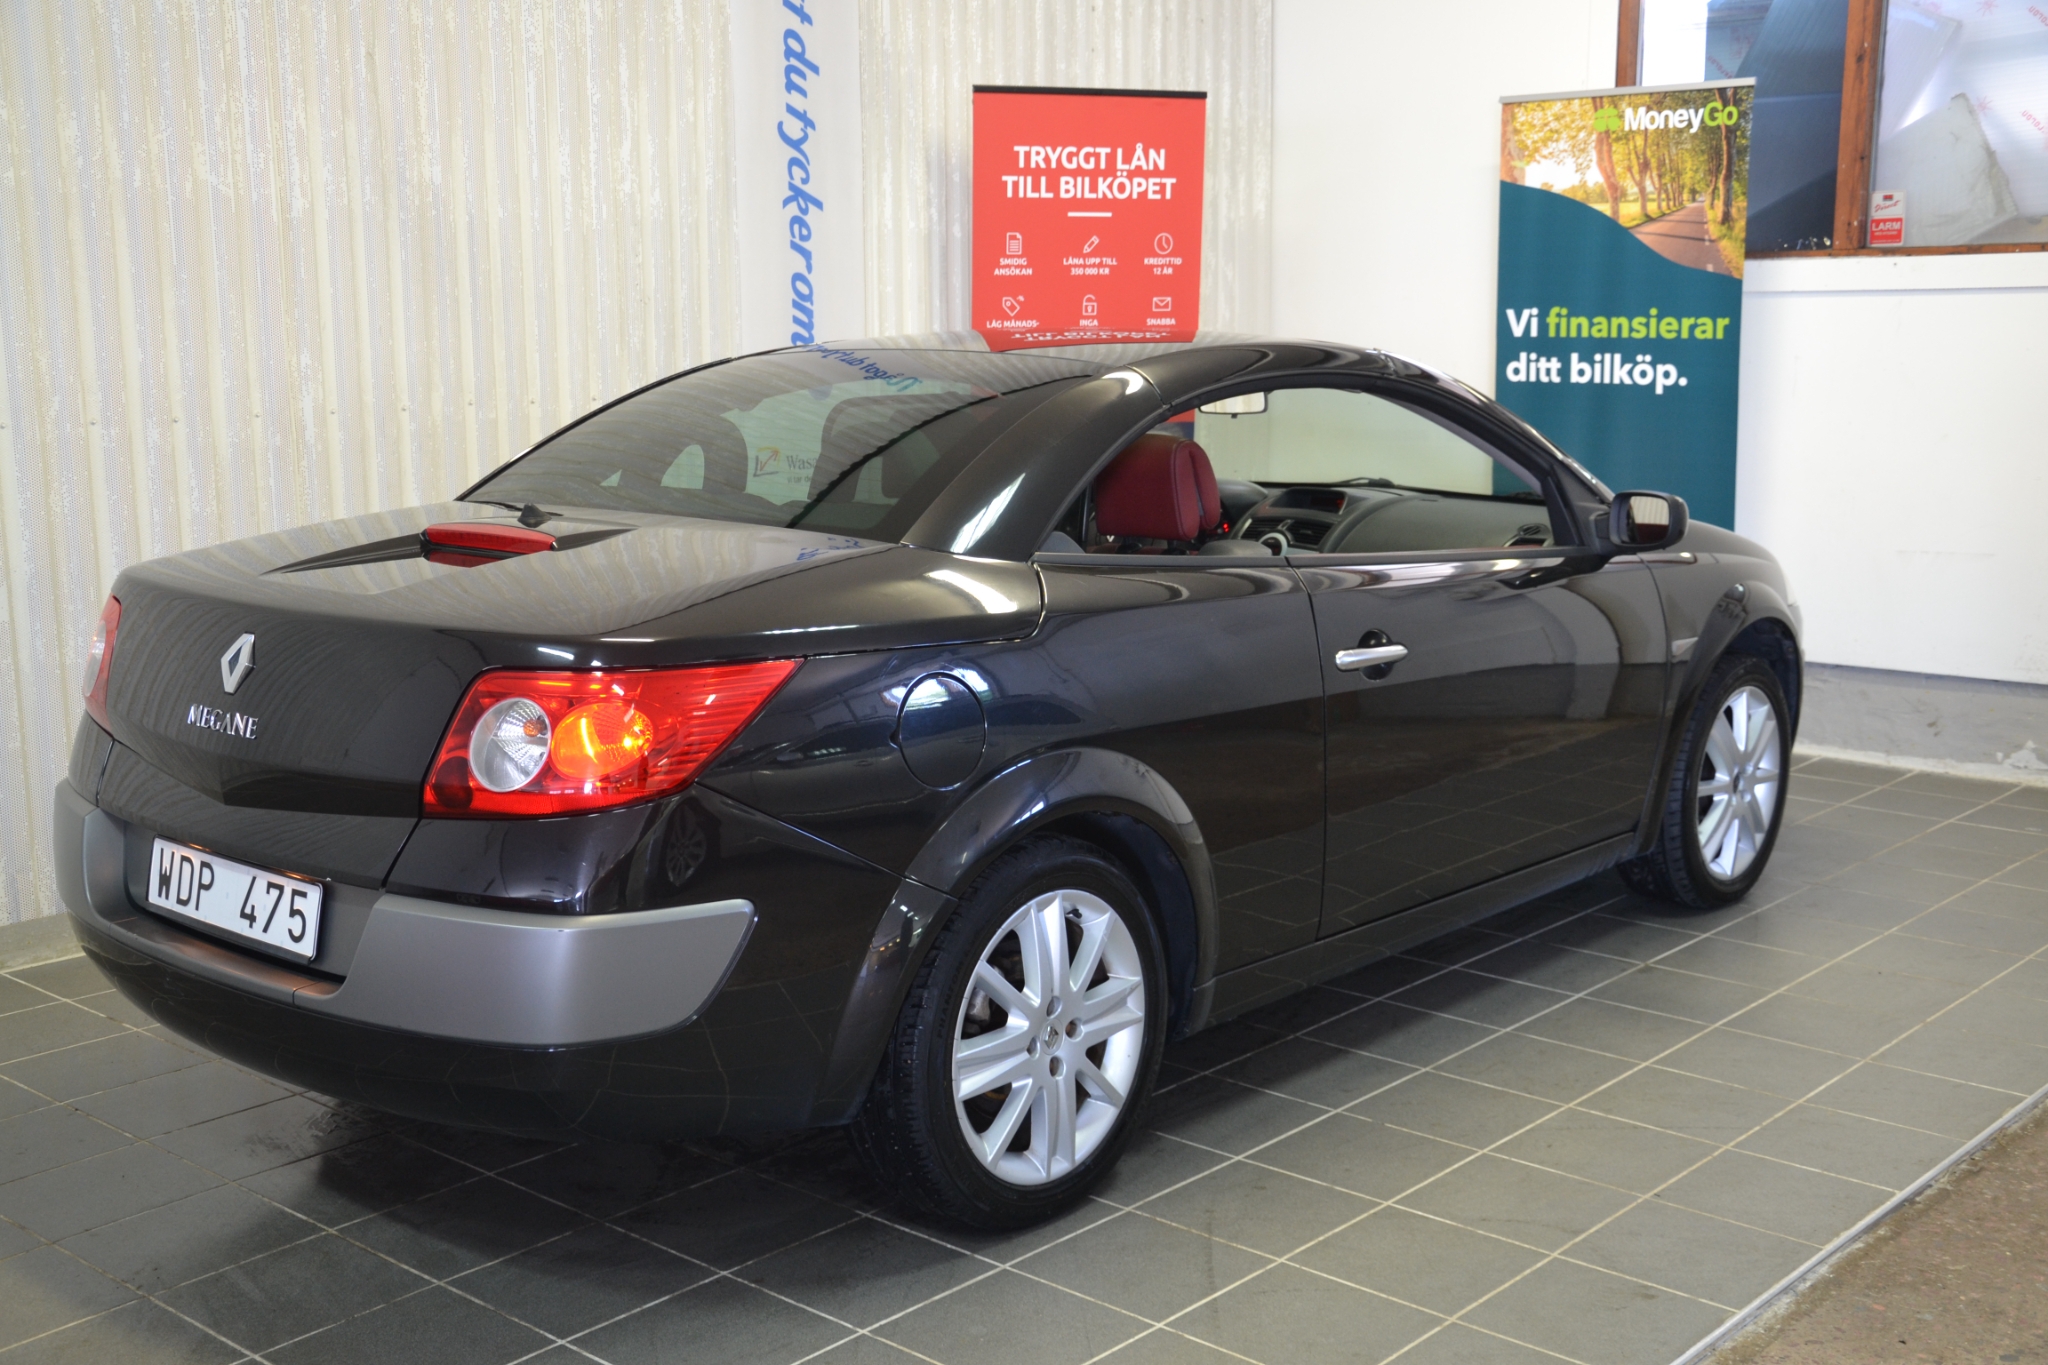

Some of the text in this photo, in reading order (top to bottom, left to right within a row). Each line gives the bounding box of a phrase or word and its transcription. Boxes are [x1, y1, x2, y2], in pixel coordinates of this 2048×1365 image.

[783, 0, 812, 26] t
[783, 28, 820, 99] du
[1624, 101, 1739, 133] MoneyGo
[1013, 142, 1166, 171] TRYGGT LÅN
[777, 102, 824, 275] tycker
[1001, 170, 1177, 200] TILL BILKÖPET
[1871, 221, 1901, 231] LARM
[993, 265, 1033, 276] ANSÖKAN
[999, 257, 1028, 267] SMIDIG
[1063, 256, 1118, 266] LÅNA UPP TILL
[1143, 257, 1183, 266] KREDITTID
[1153, 265, 1173, 275] 12 ÅR
[1070, 267, 1110, 276] 350 000 KR
[986, 317, 1040, 329] LÅG MÅNADS-
[1079, 318, 1099, 327] INGA
[1146, 317, 1176, 326] SNABBA
[1505, 306, 1730, 340] Vi finansierar
[1506, 352, 1688, 395] ditt bilköp.
[187, 703, 259, 740] MEGANE
[157, 847, 308, 944] WDP 475
